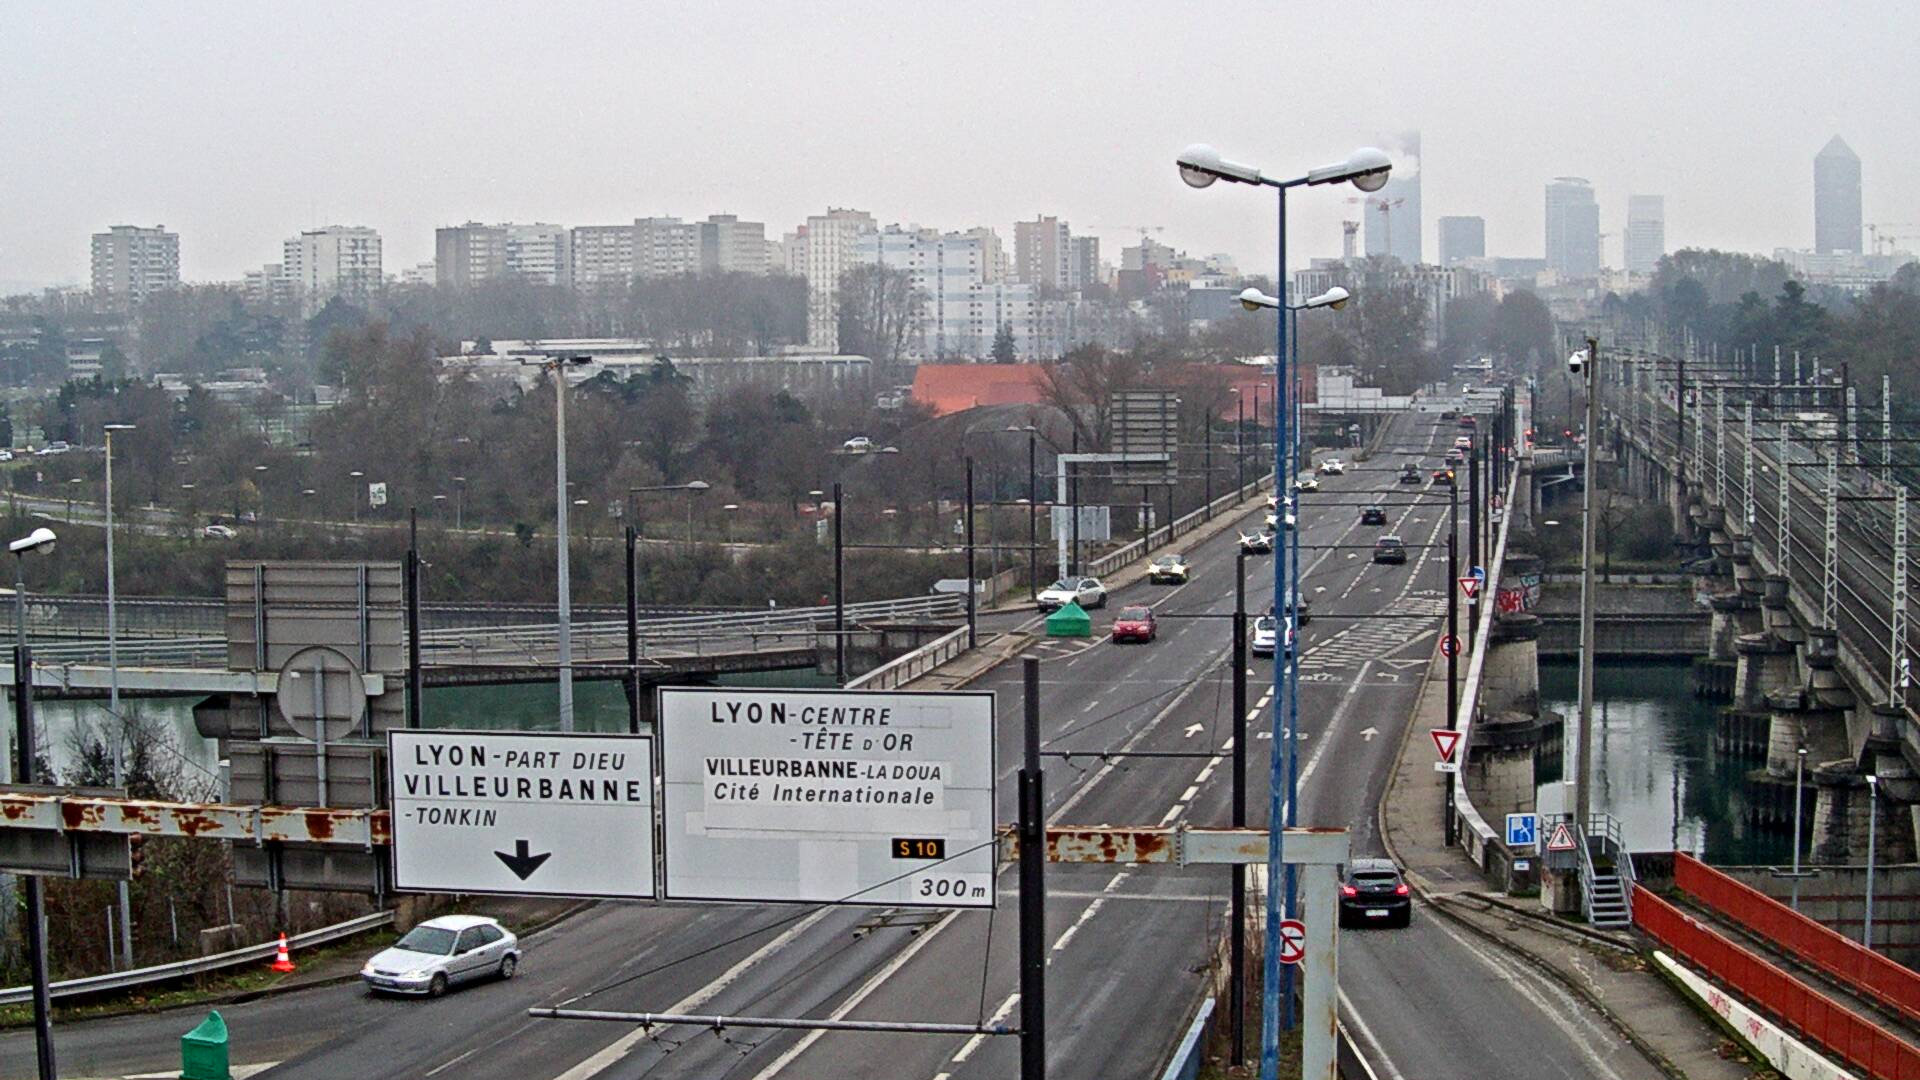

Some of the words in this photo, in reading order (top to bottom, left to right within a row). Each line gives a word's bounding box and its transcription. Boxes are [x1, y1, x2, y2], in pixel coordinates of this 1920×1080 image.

[572, 752, 626, 771] DIEU
[892, 765, 942, 781] DOUA
[404, 774, 641, 802] VILLEURBANNE
[713, 782, 760, 801] Cité
[772, 783, 935, 805] Internationale
[920, 878, 967, 897] 300
[971, 886, 986, 898] m
